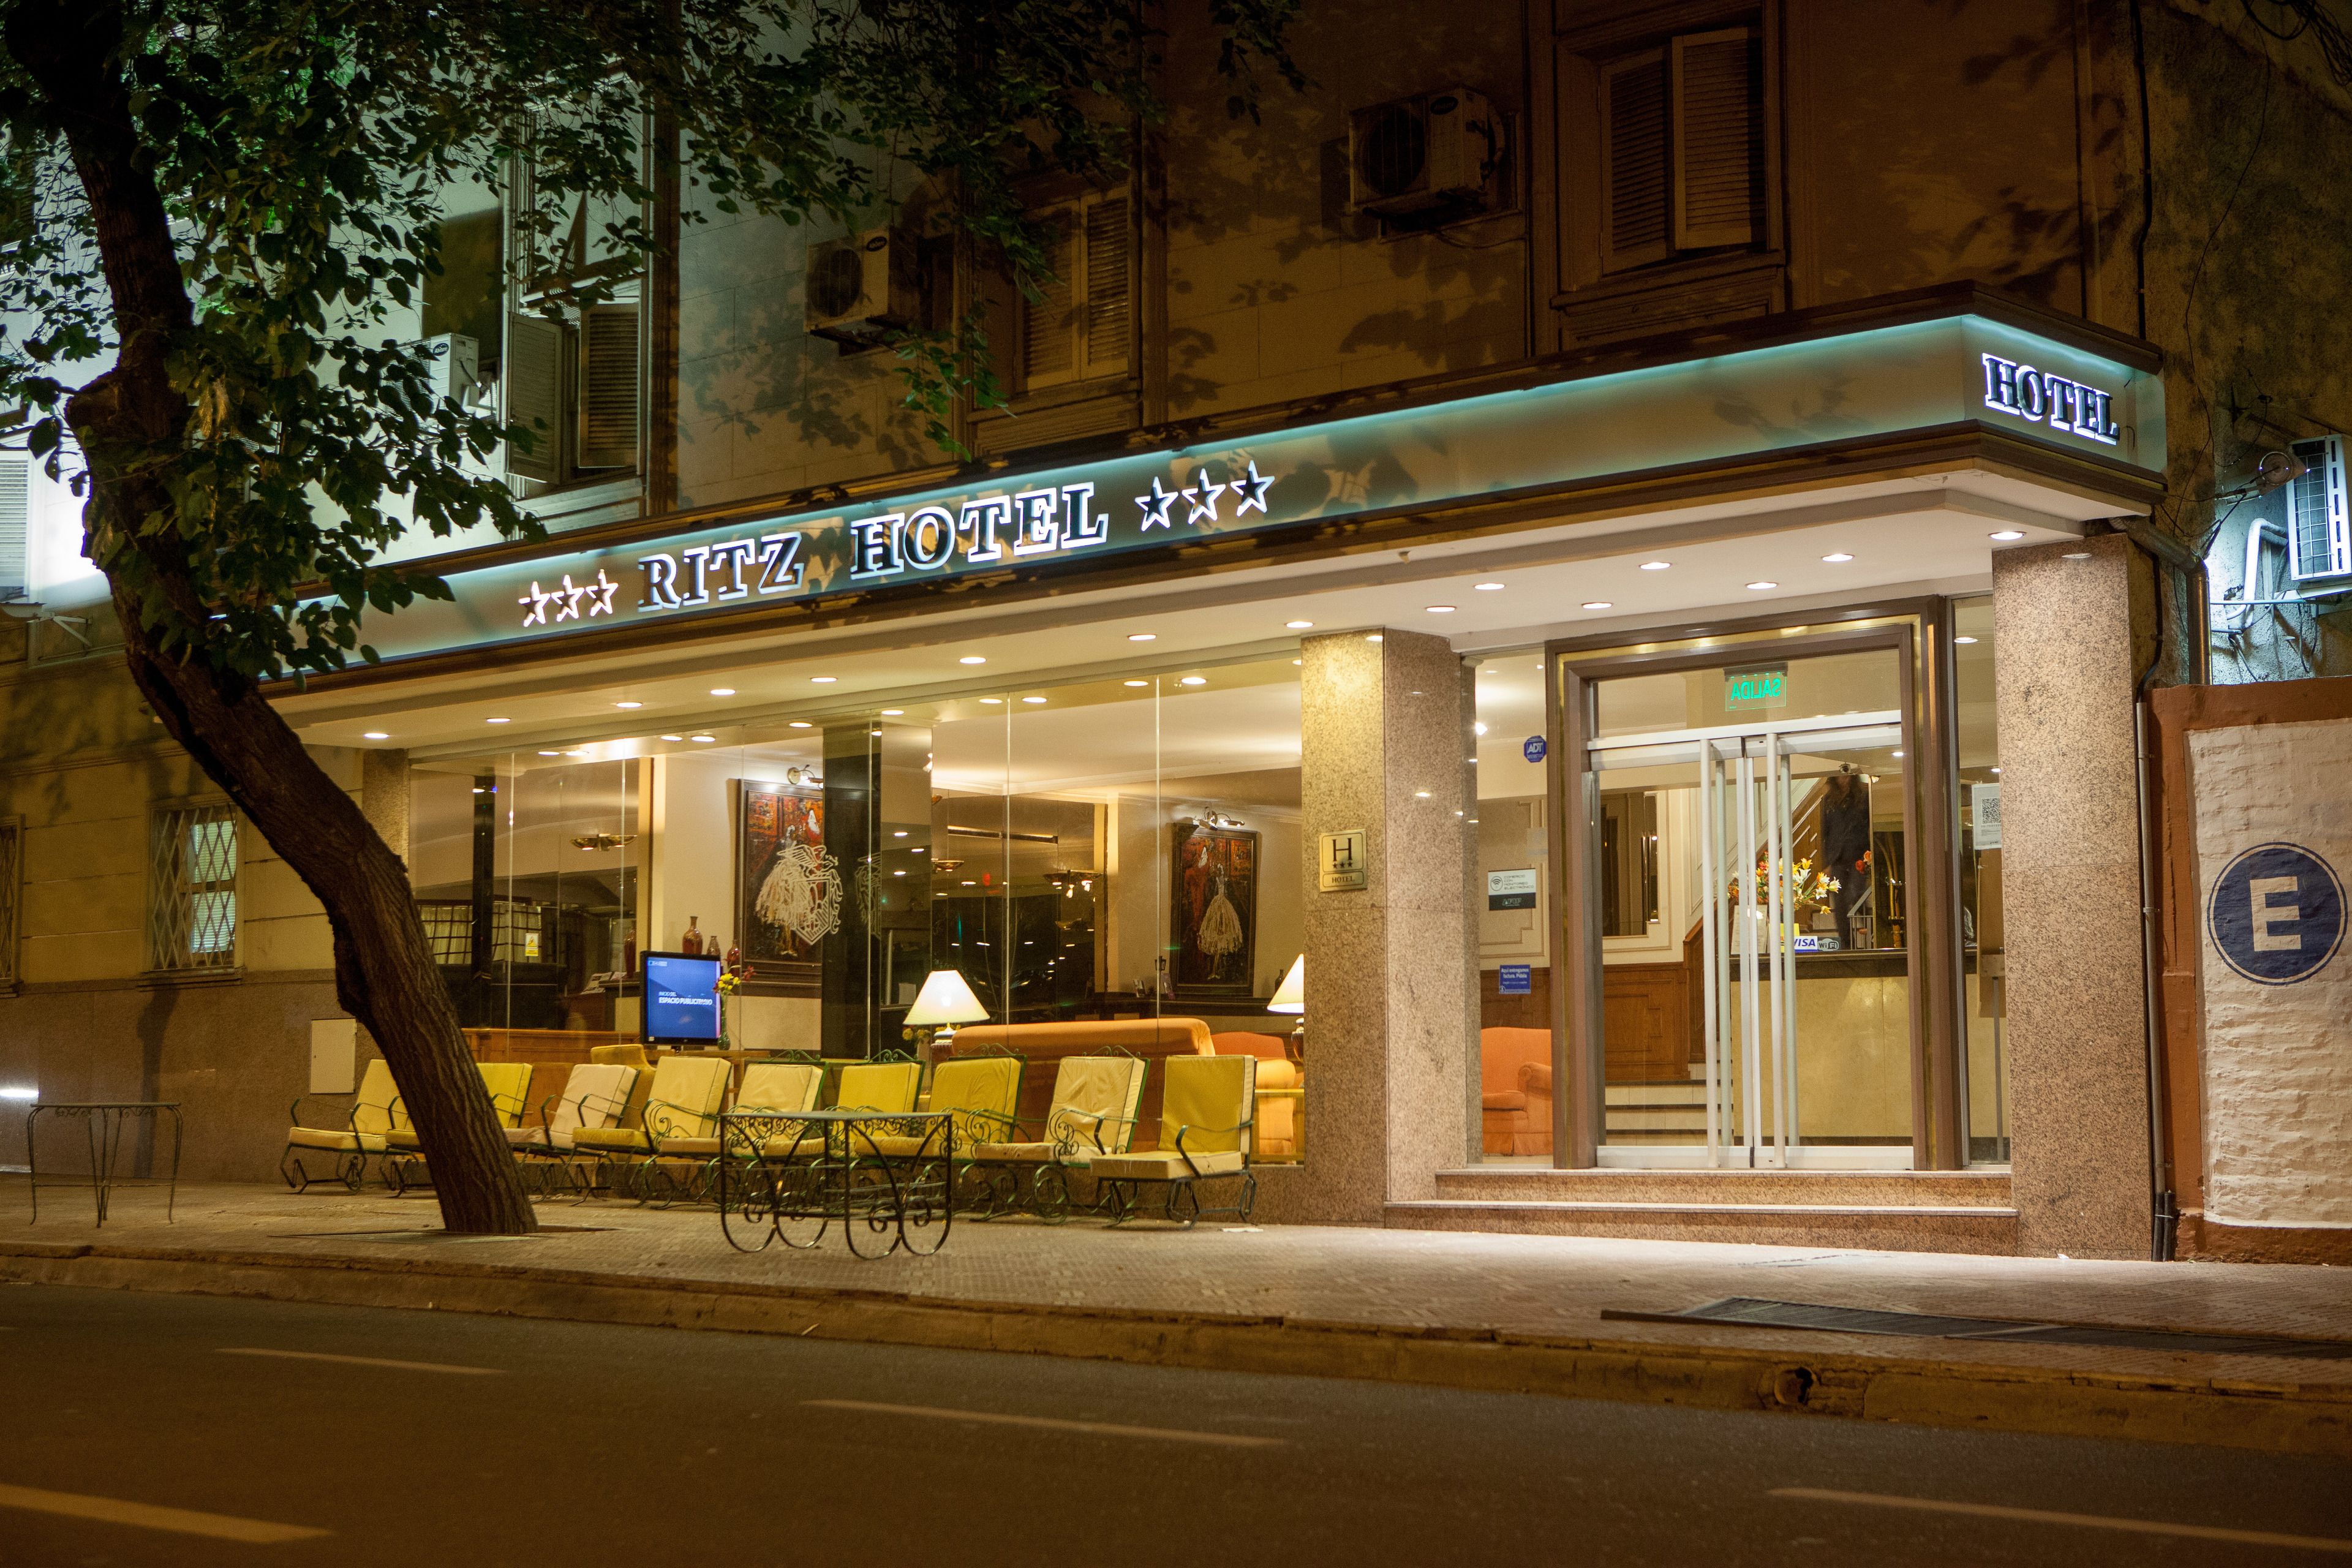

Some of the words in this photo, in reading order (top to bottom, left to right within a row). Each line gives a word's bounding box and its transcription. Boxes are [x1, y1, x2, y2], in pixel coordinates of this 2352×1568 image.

[1982, 352, 2120, 446] HOTEL
[638, 531, 805, 612] RITZ
[850, 481, 1109, 580] HOTEL
[1527, 742, 1543, 753] ADT
[1332, 838, 1352, 862] H
[2250, 876, 2301, 952] E
